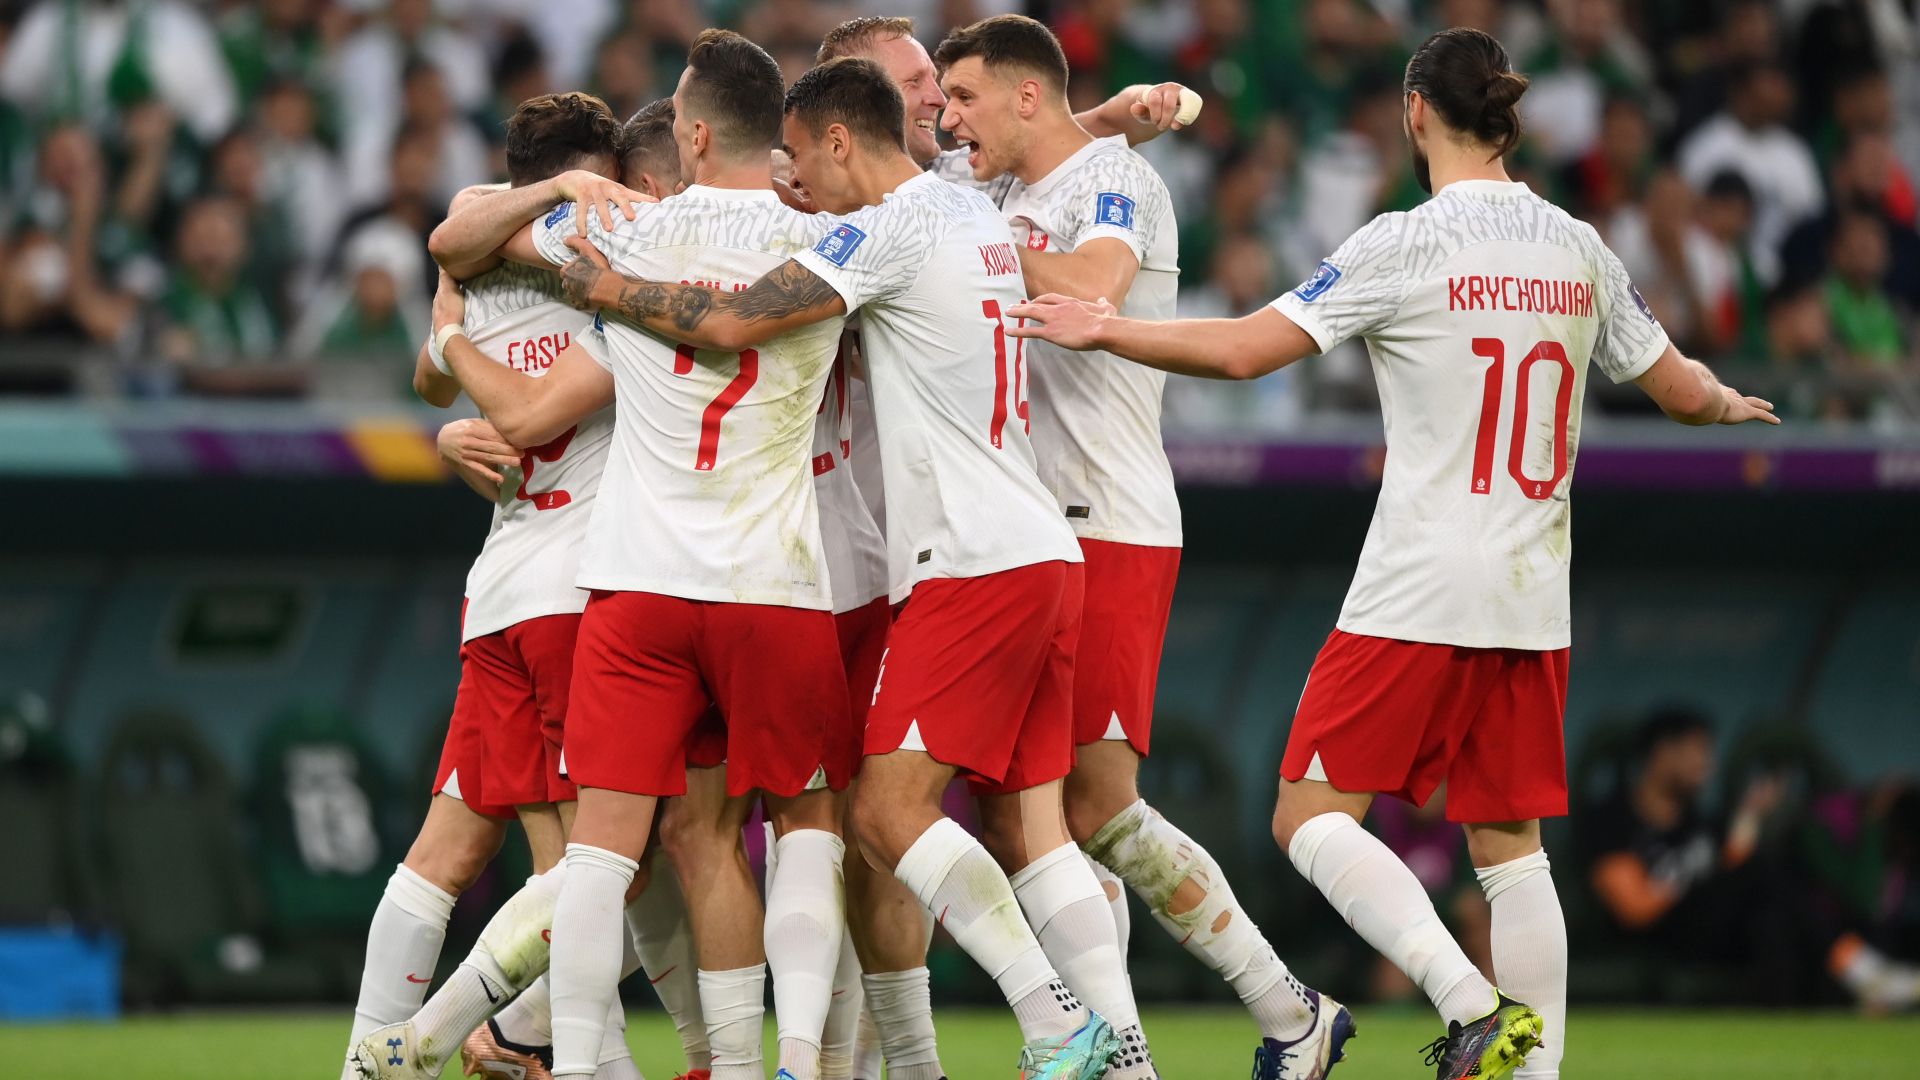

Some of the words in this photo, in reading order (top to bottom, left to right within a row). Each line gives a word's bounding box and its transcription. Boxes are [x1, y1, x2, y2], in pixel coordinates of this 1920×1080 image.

[1448, 275, 1594, 318] KRYCHOWIAK
[507, 331, 570, 372] CASH
[673, 342, 759, 471] 7
[1470, 337, 1575, 500] 10
